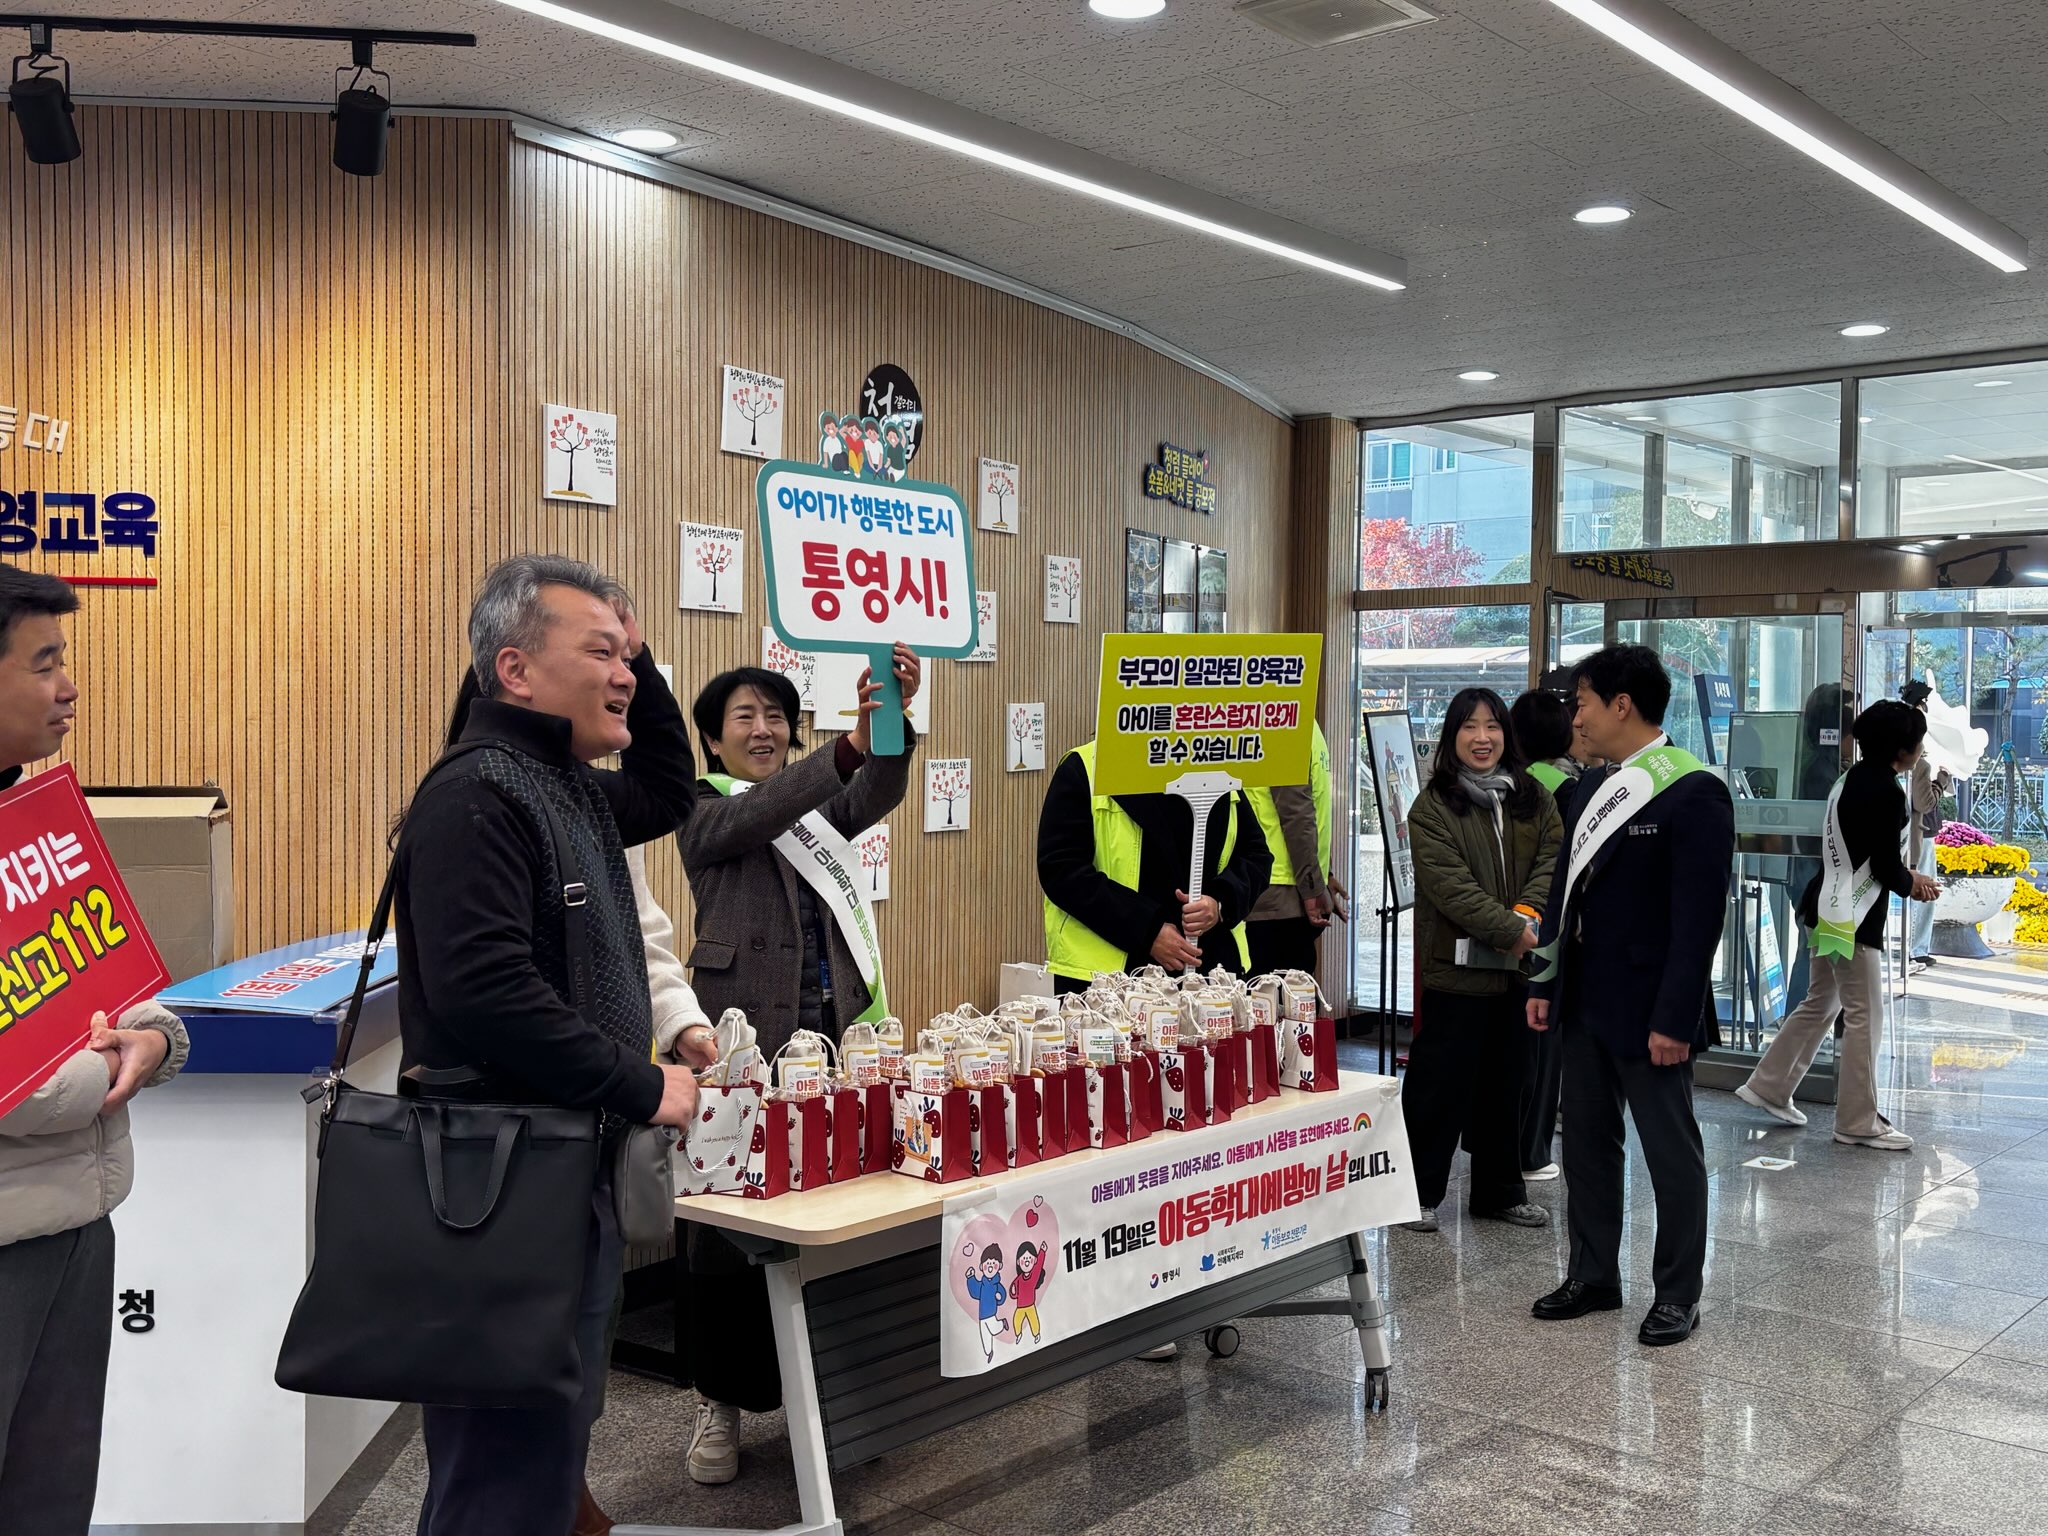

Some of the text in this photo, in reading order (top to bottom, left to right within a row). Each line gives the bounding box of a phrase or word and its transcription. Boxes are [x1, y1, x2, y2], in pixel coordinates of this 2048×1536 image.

[1164, 446, 1204, 482] 청렴 플레이
[777, 486, 955, 538] 아이가 행복한 도시
[1195, 483, 1216, 512] 공모전
[801, 540, 950, 624] 통영시!
[1118, 656, 1304, 688] 부모의 일관된 양육관
[1118, 701, 1299, 732] 아이를 혼란스럽지 않게
[1191, 735, 1264, 763] 있습니다.
[1657, 753, 1679, 774] stop!
[1586, 786, 1631, 835] 아동학대
[0, 831, 91, 912] 지키는
[0, 885, 128, 1030] 신고112
[1091, 1117, 1353, 1205] 아동에게 웃음을 지어주세요. 아동에게 사랑을 표현해주세요.
[1063, 1236, 1098, 1274] 11월
[1101, 1219, 1158, 1261] 19일은
[1157, 1163, 1323, 1248] 아동학대예방의
[1161, 1266, 1182, 1284] 통영시
[117, 1289, 155, 1333] 청
